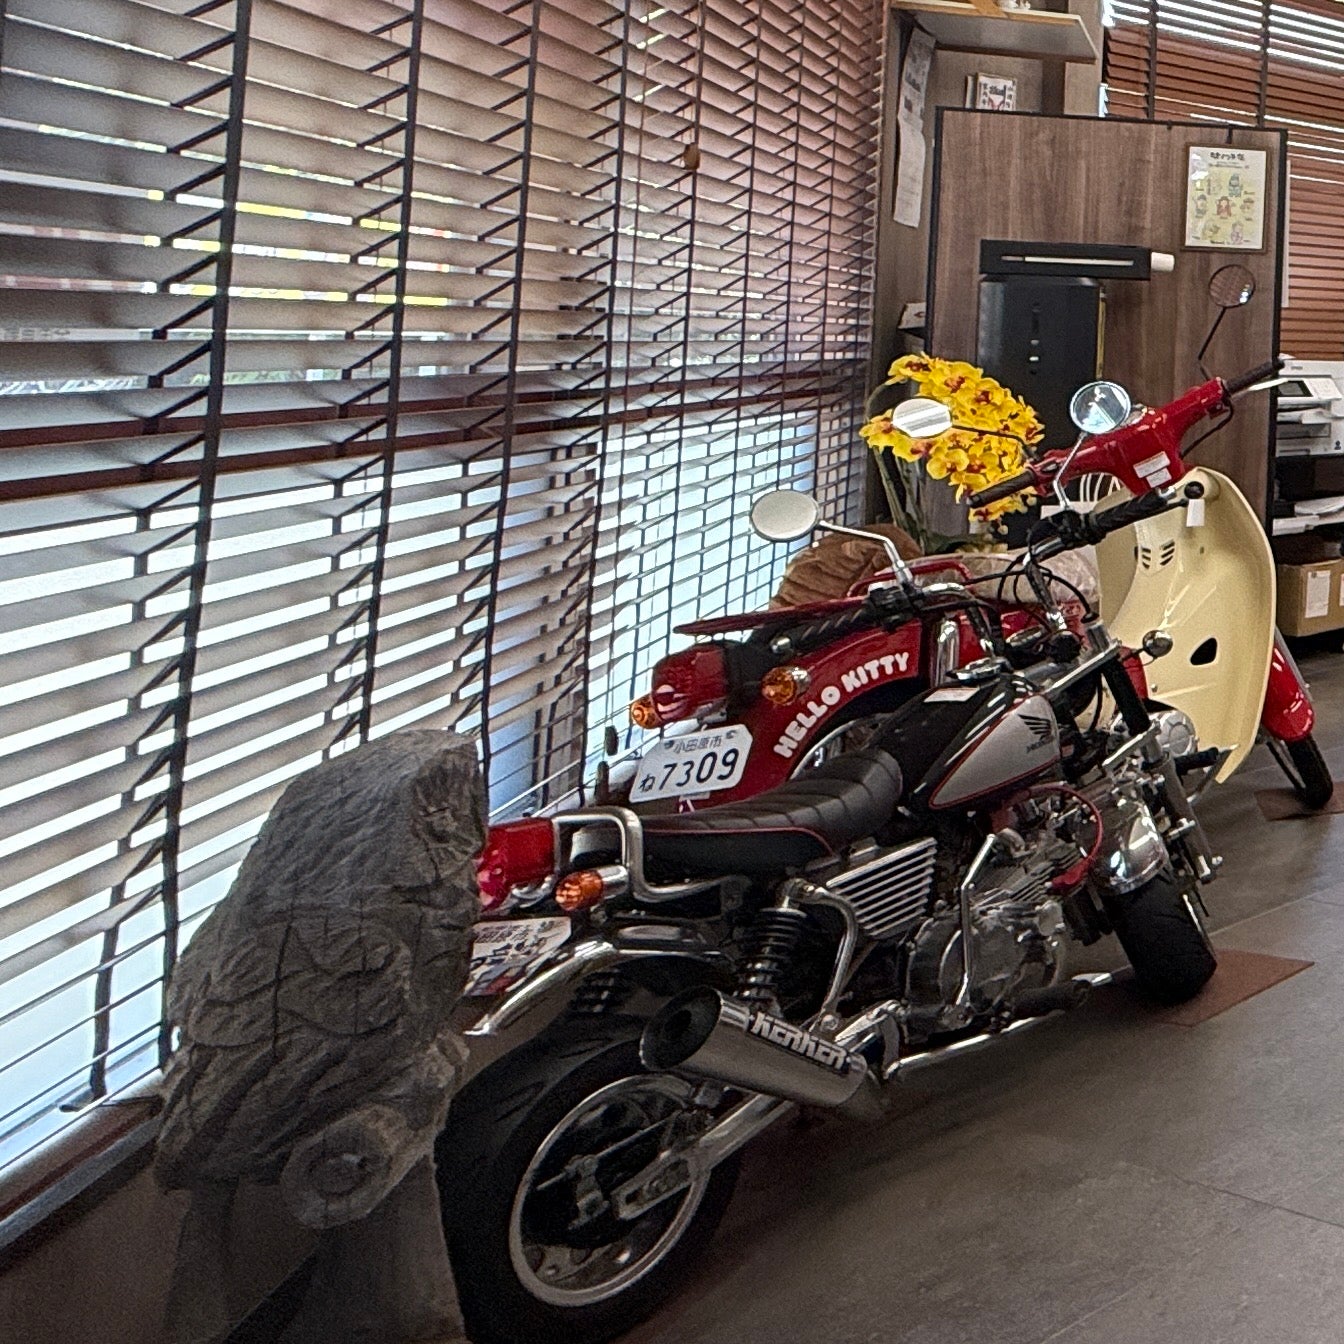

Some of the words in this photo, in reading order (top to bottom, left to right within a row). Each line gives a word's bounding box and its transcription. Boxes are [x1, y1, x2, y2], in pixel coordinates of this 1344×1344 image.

[773, 685, 841, 758] HELLO
[840, 652, 909, 693] KITTY
[658, 747, 740, 791] 7309
[674, 735, 722, 754] 小田原市
[750, 1011, 848, 1070] KERKER
